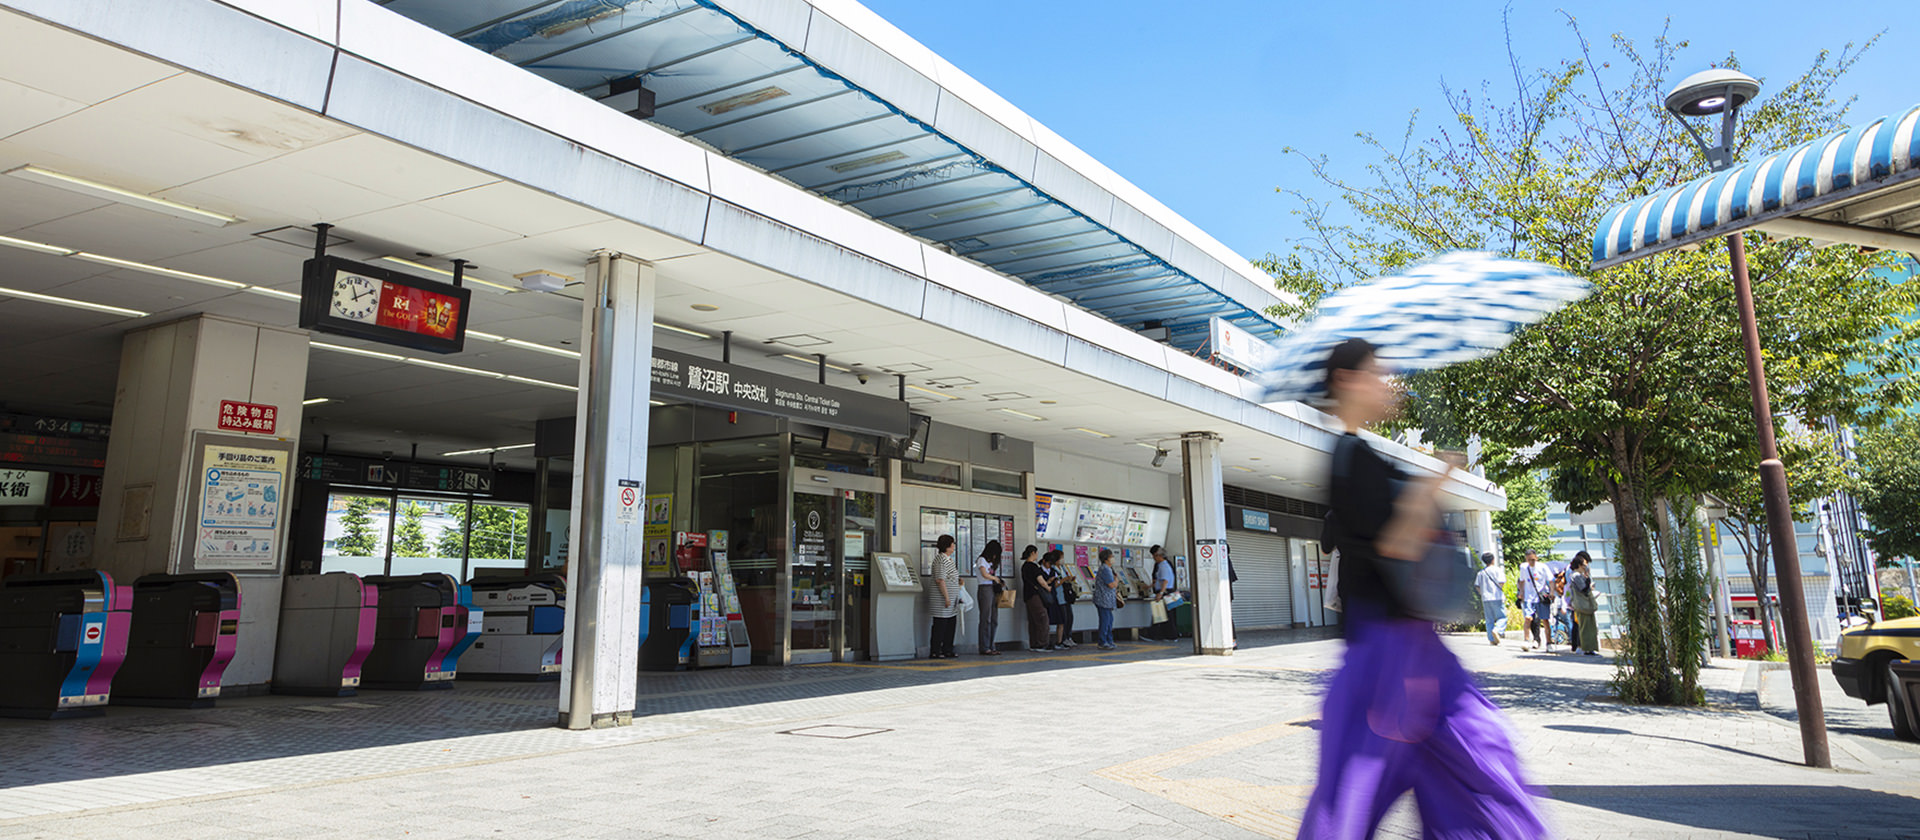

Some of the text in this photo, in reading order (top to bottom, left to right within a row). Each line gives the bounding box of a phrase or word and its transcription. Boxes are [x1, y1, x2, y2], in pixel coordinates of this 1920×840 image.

[687, 365, 769, 403] 鷺沼駅 中央改札
[223, 403, 274, 419] 危険物品
[221, 415, 273, 430] 持込み厳禁
[218, 452, 276, 464] 手回り品のご案内
